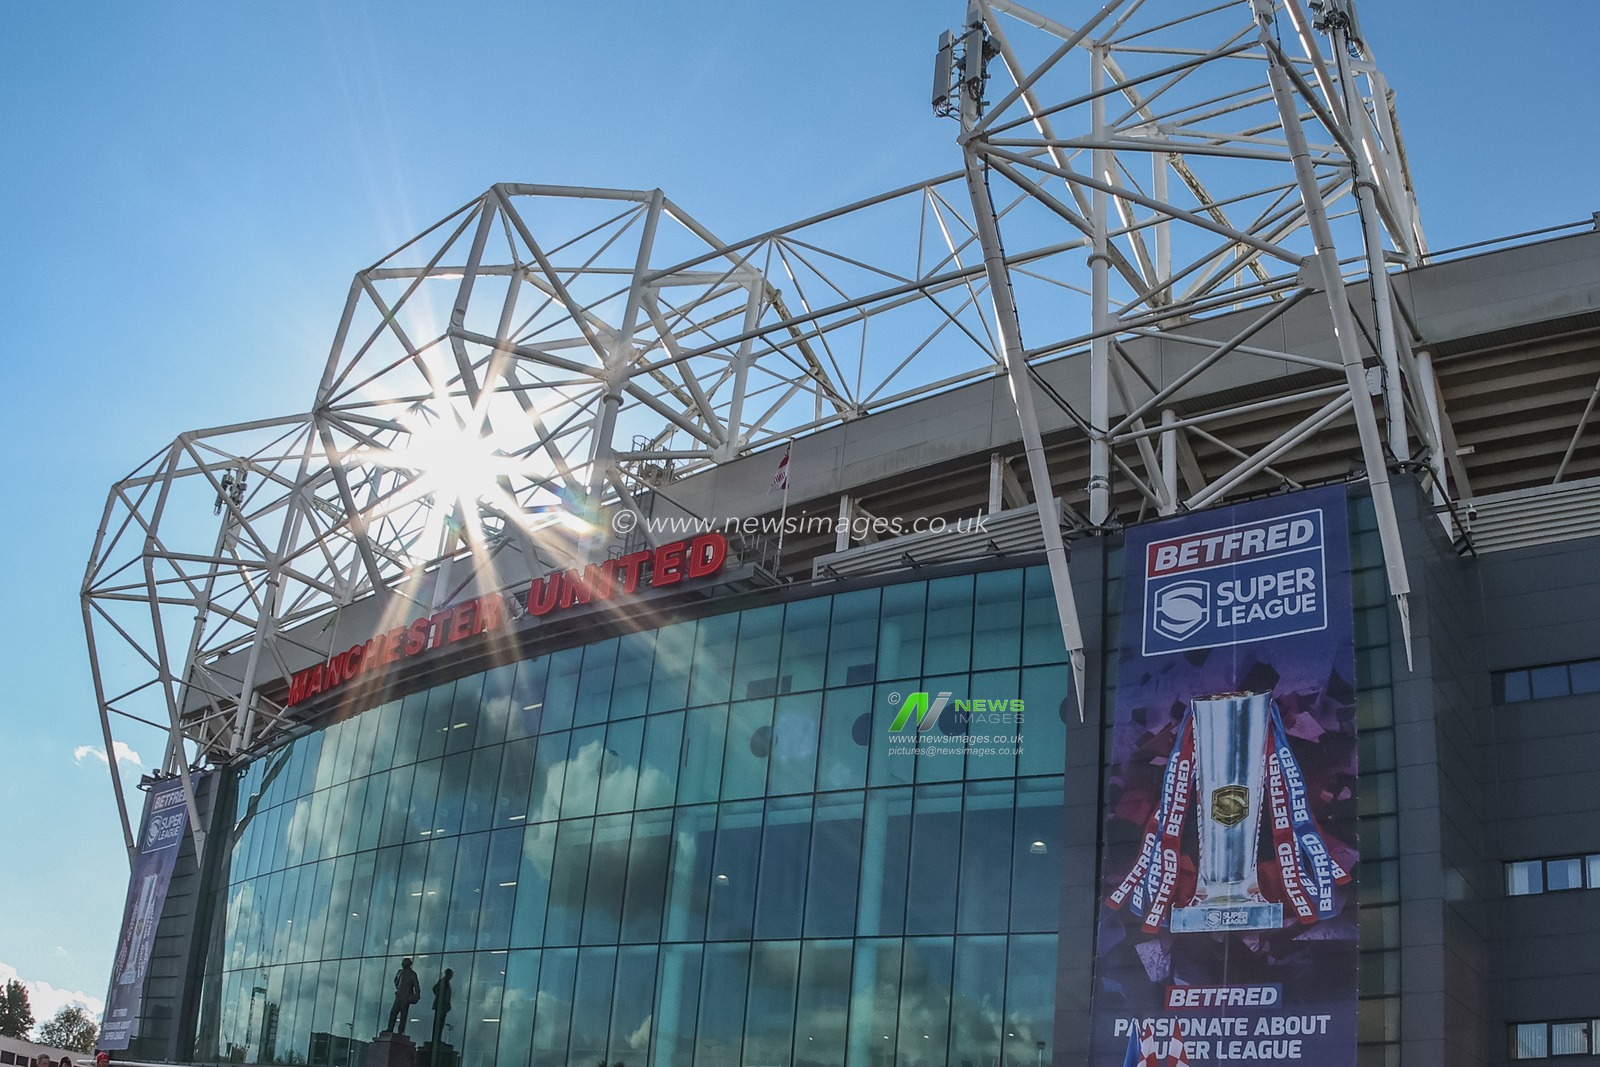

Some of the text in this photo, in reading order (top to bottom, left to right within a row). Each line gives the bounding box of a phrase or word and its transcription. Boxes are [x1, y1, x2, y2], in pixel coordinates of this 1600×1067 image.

[1154, 519, 1315, 572] BETFRED
[287, 533, 728, 707] MANCHESTER UNITED
[1216, 567, 1316, 606] SUPER
[1216, 592, 1317, 628] LEAGUE
[154, 789, 187, 810] BETFRE
[1165, 759, 1190, 837] BETFRED
[1269, 753, 1290, 830] BETFRED
[1278, 746, 1310, 822] BETFRED
[1110, 832, 1157, 904] BETFRED
[1145, 848, 1178, 927] BETFRED
[1277, 842, 1313, 917] BETFRED
[1301, 833, 1332, 912] BETFRED
[1168, 986, 1279, 1007] BETFRED
[1254, 1015, 1331, 1036] ABOUT
[1216, 1040, 1302, 1060] LEAGUE
